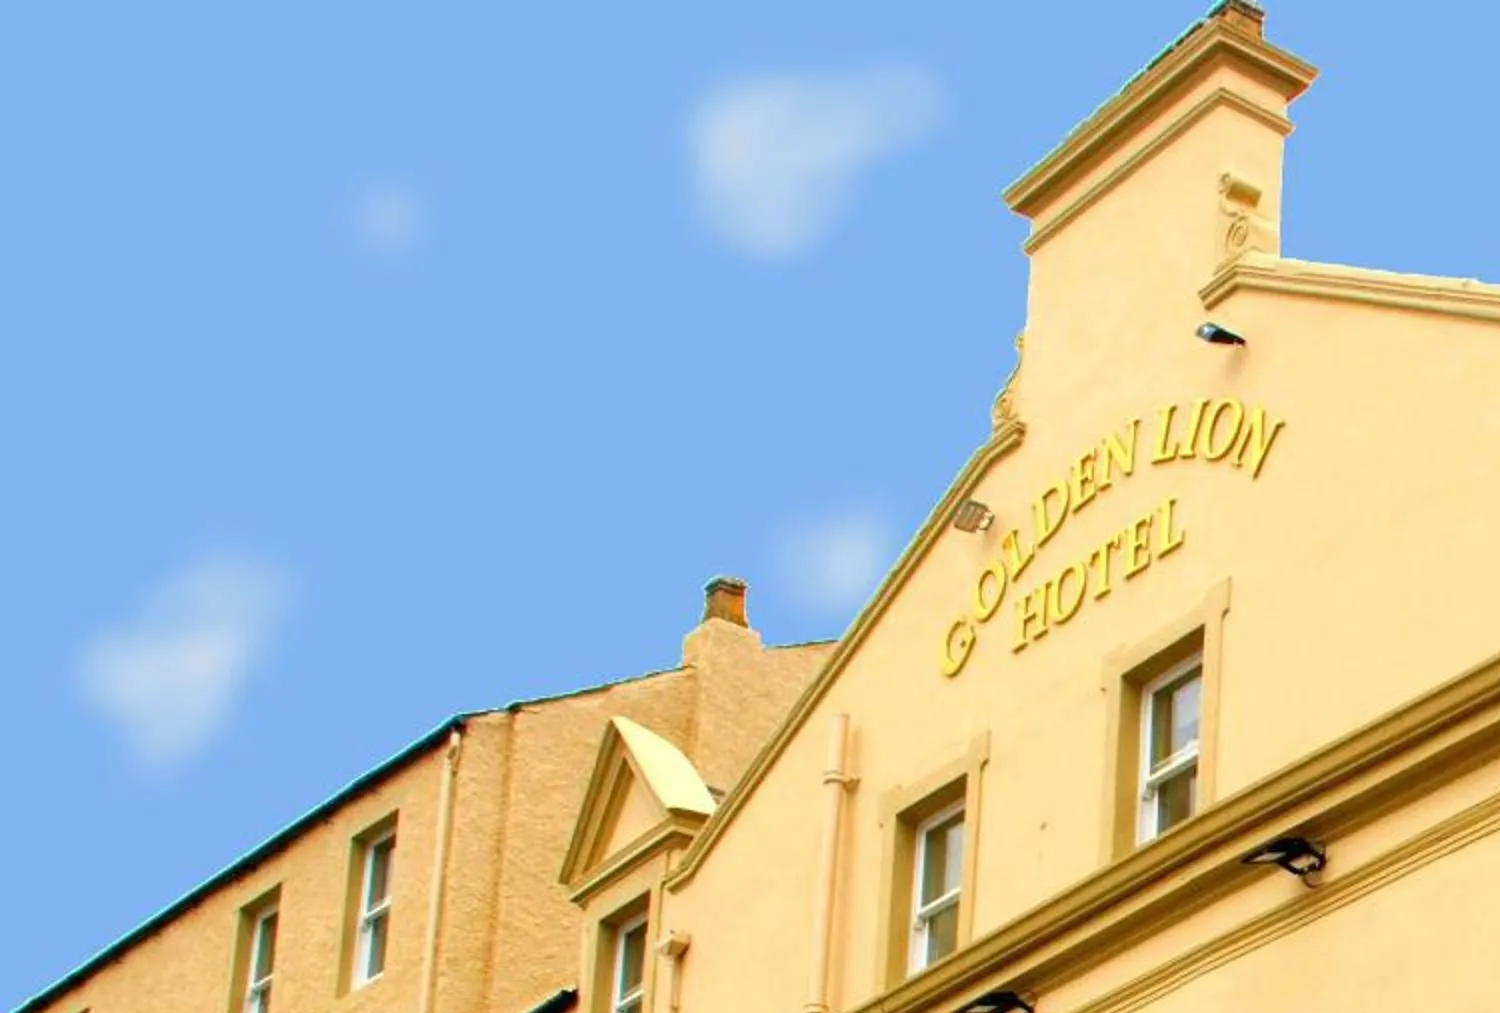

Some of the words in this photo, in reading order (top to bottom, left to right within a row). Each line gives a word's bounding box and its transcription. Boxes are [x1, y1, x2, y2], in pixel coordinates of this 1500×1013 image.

[941, 419, 1141, 677] GOLDEN
[1151, 398, 1285, 480] LION
[1012, 499, 1185, 653] HOTEL
